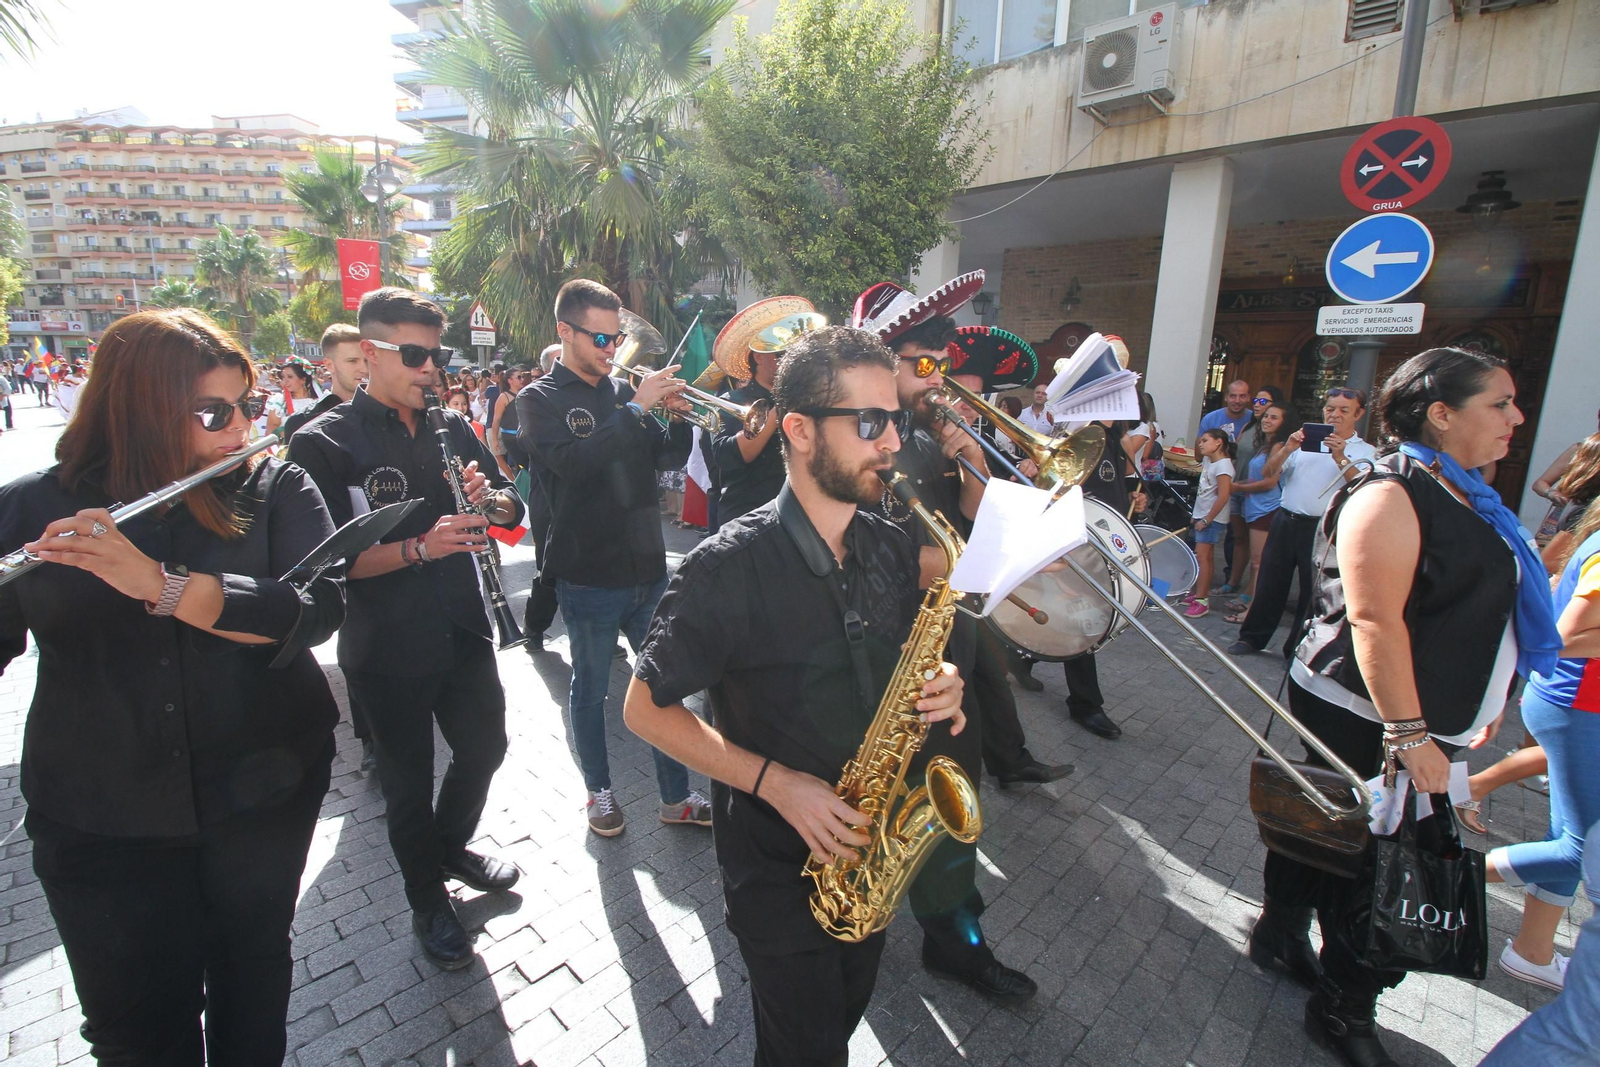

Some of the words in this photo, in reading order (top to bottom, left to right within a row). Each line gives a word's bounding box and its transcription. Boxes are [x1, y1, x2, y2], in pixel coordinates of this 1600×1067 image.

[1149, 27, 1161, 36] LG
[1372, 201, 1403, 211] GRUA
[1363, 316, 1413, 324] EMERGENCIAS
[1398, 898, 1468, 931] LOLA
